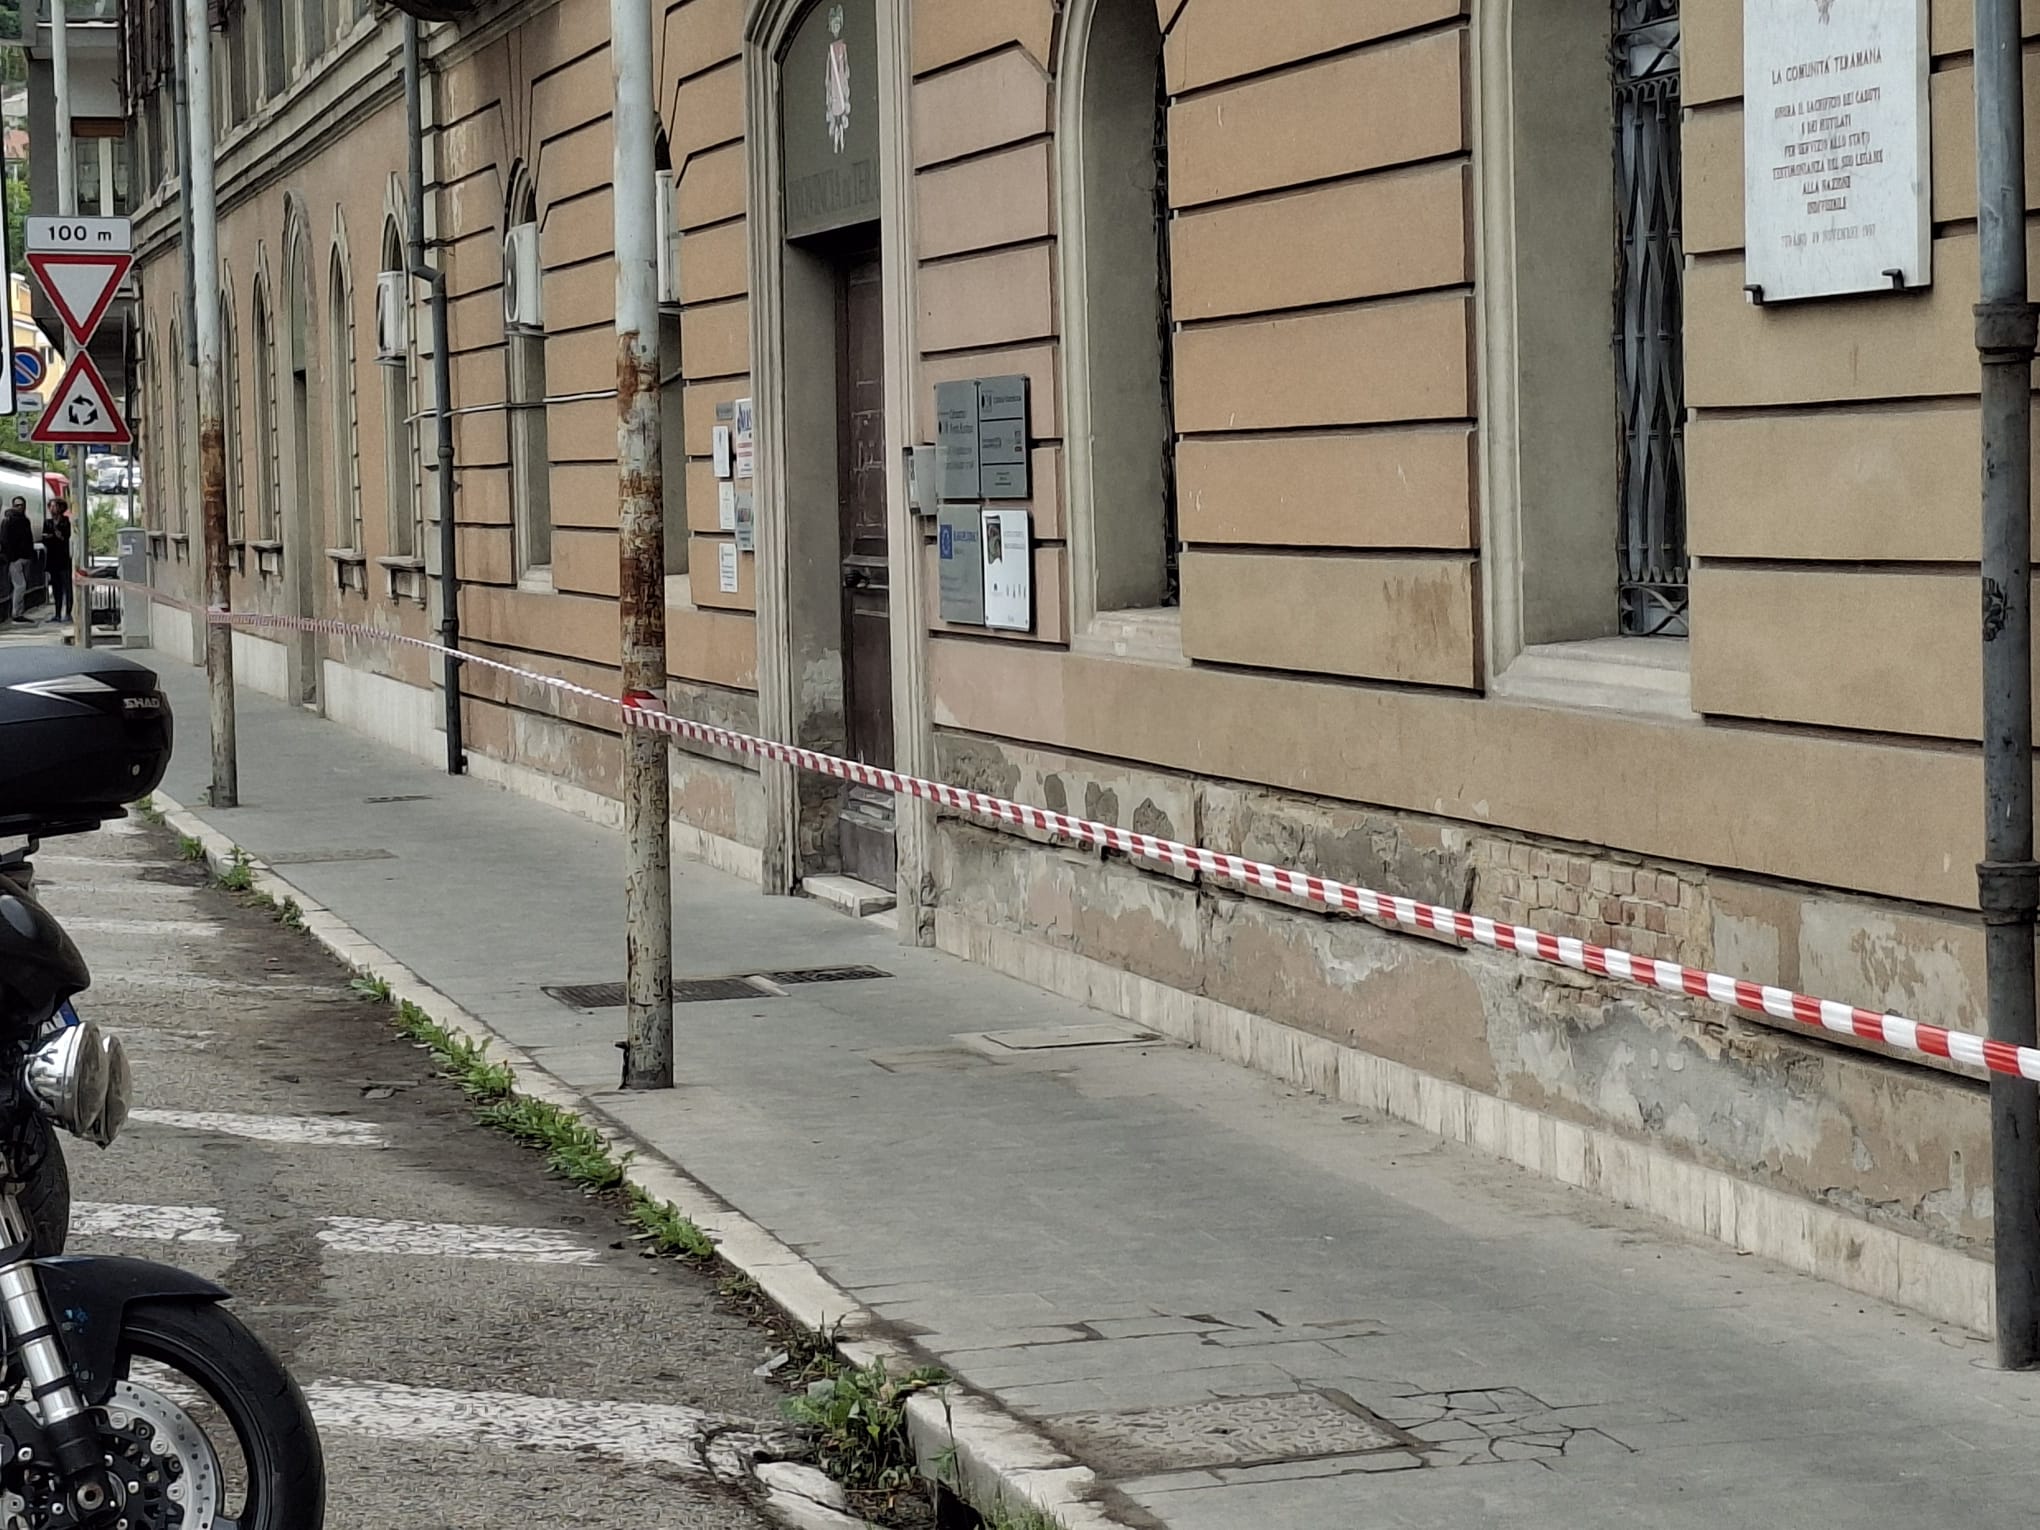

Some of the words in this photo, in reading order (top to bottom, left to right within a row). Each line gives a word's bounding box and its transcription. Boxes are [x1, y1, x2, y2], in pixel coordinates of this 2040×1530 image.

[1772, 69, 1782, 85] LA
[1833, 48, 1882, 73] TERAMANA
[48, 225, 87, 241] 100
[98, 231, 112, 241] m
[123, 698, 161, 709] SHAD
